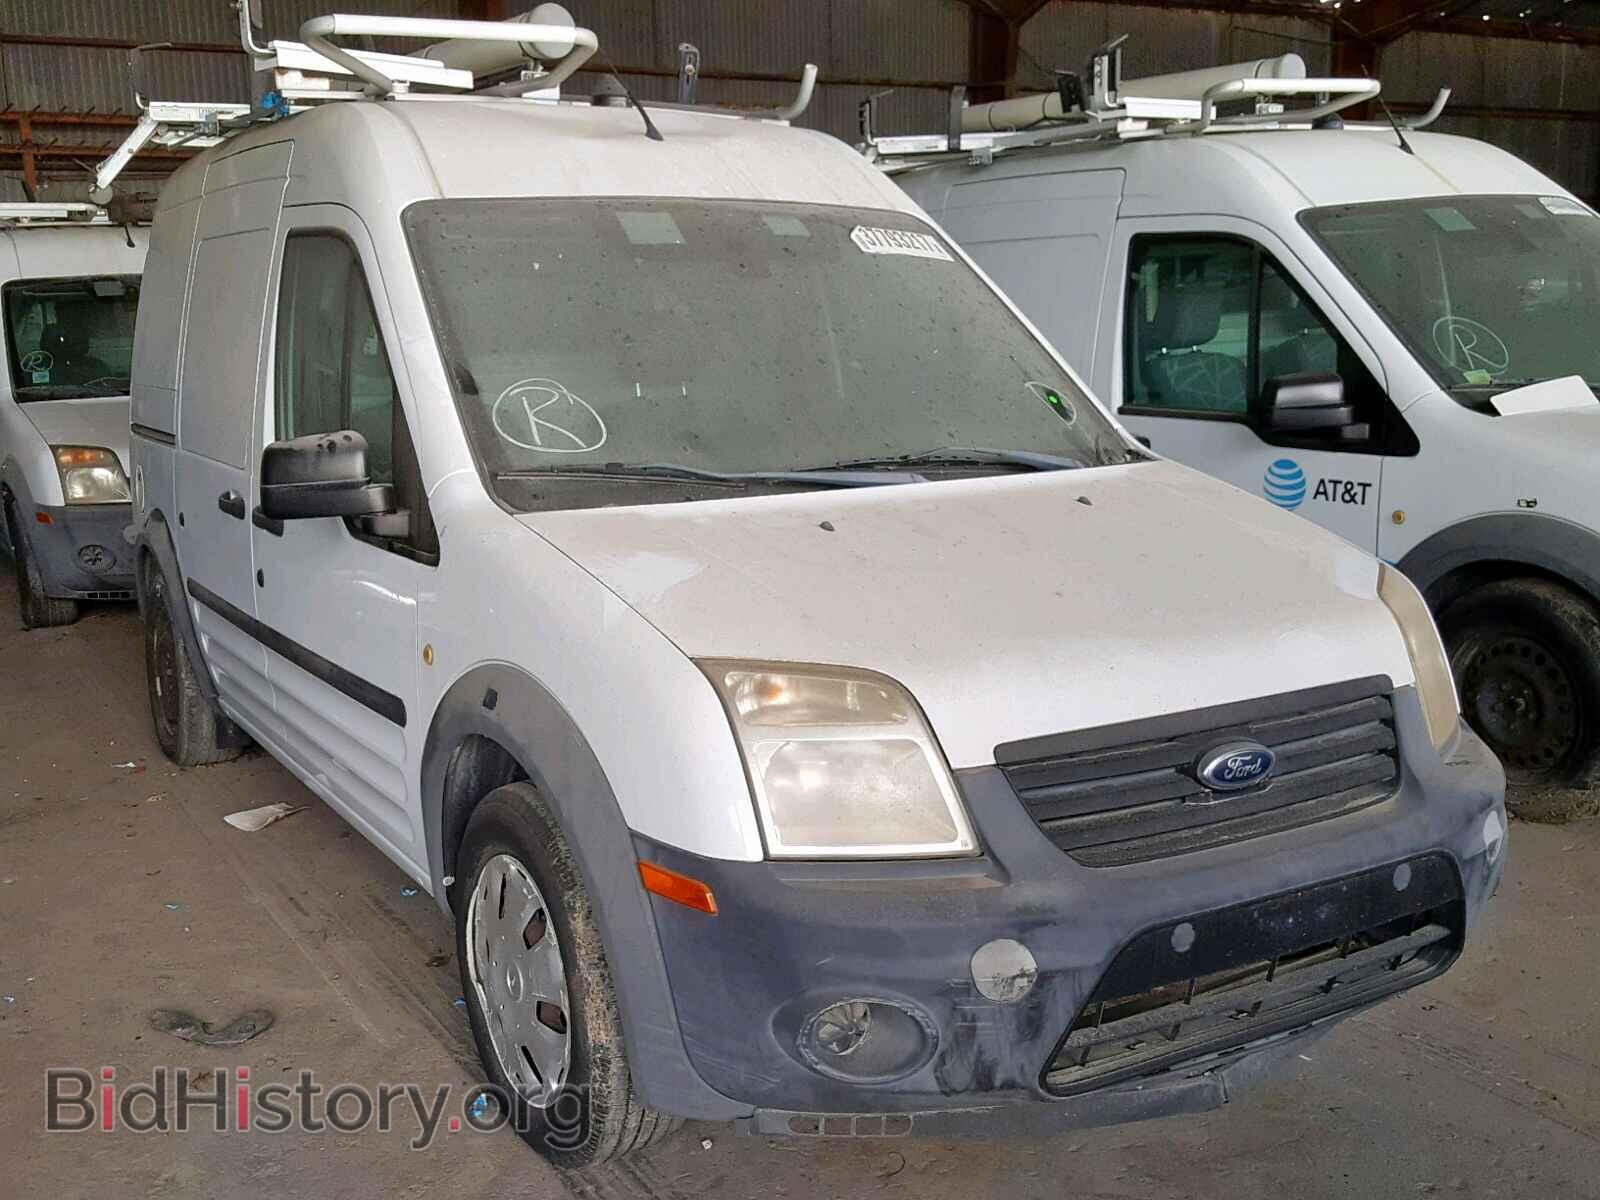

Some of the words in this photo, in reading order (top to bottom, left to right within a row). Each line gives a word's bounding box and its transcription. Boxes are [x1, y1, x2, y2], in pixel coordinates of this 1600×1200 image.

[1449, 324, 1504, 370] R
[508, 386, 588, 449] R
[1312, 478, 1373, 505] AT&T
[1224, 755, 1262, 780] Ford
